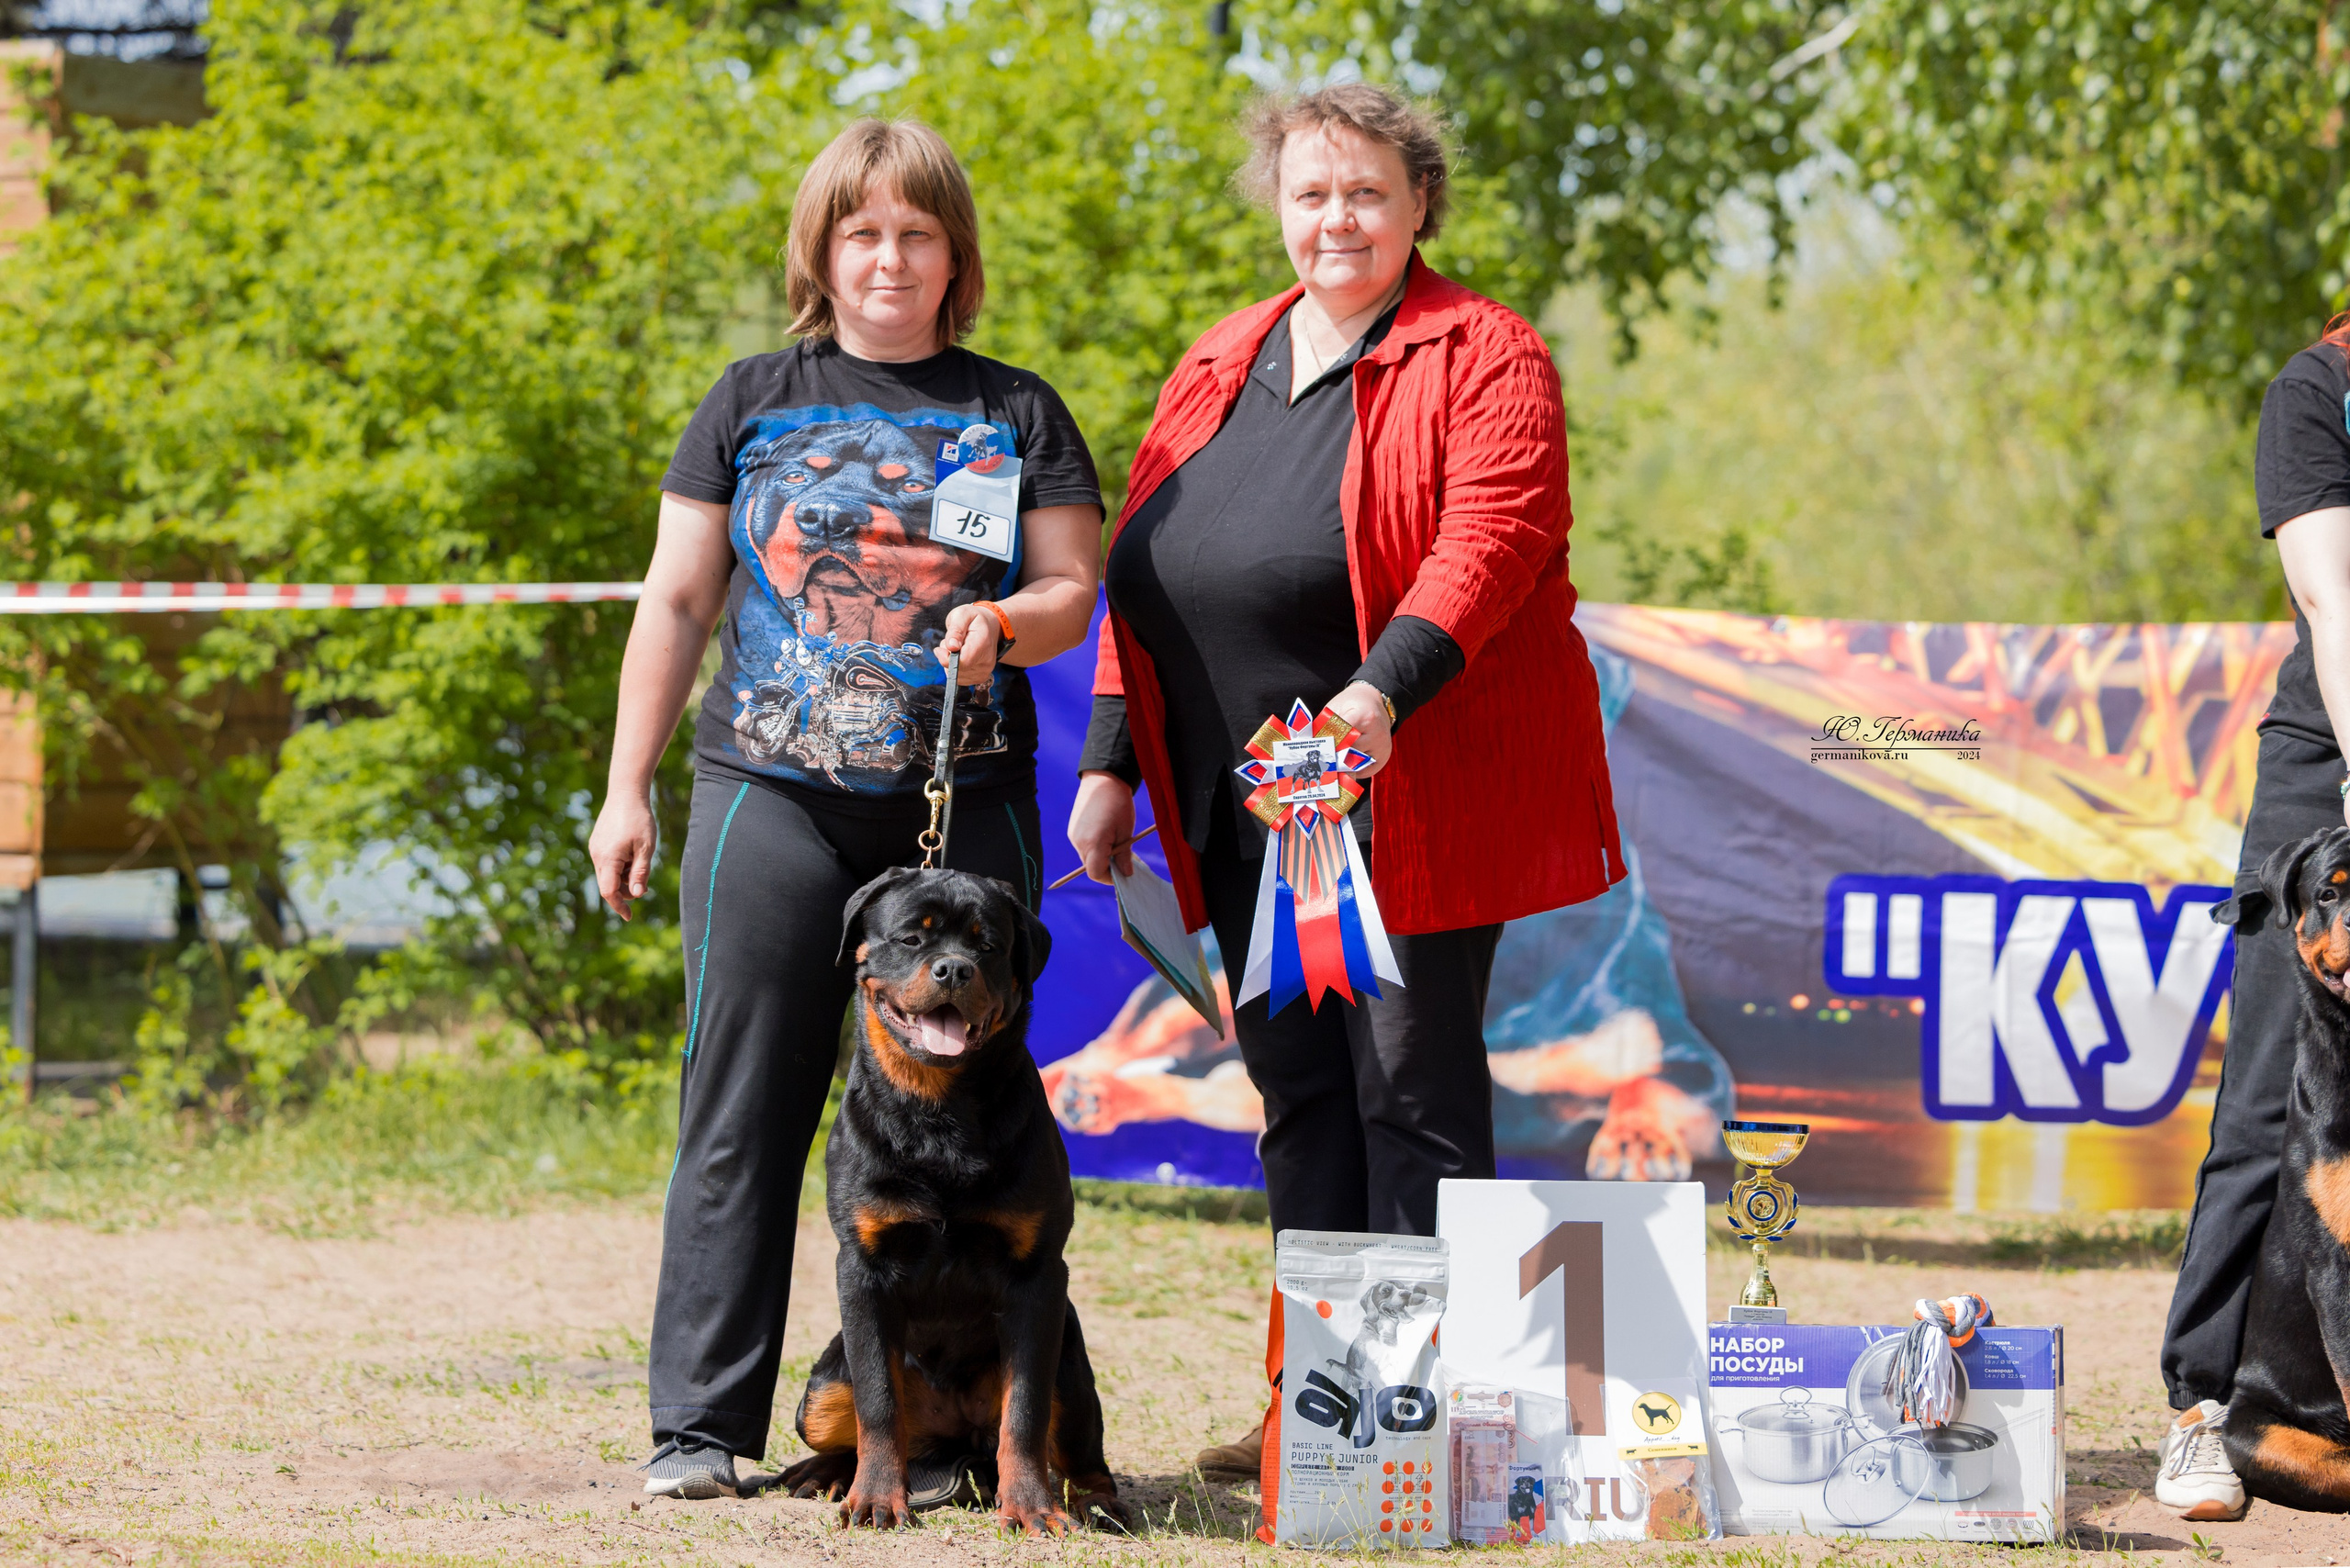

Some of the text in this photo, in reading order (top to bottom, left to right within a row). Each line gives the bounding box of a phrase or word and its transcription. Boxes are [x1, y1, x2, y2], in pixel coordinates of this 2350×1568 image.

[957, 510, 990, 538] 15
[1518, 1220, 1606, 1437] 1
[1710, 1337, 1785, 1353] НАБОР
[1710, 1356, 1804, 1375] ПОСУДЫ
[1292, 1451, 1325, 1462] PUPPY
[1338, 1453, 1378, 1464] JUNIOR
